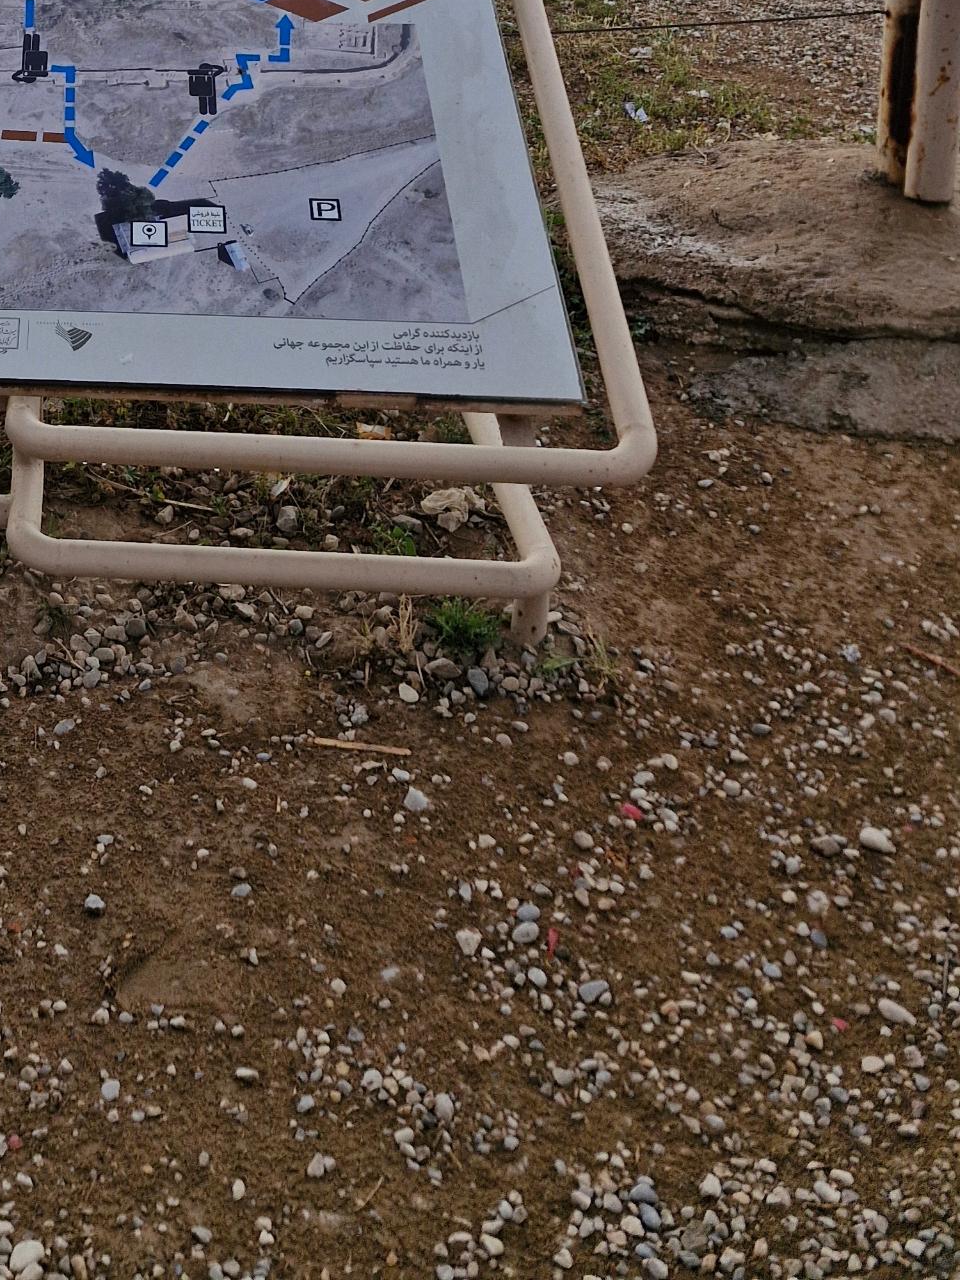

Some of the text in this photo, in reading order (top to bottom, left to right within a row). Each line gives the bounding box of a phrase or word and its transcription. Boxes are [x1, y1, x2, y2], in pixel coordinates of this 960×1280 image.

[316, 202, 336, 217] P
[393, 328, 421, 340] گرامی
[273, 338, 304, 350] جهانی
[308, 340, 350, 352] مجموعه
[353, 341, 369, 352] این
[382, 341, 421, 351] حفاظت
[424, 343, 444, 355] برای
[447, 344, 472, 356] اینکه
[384, 357, 419, 368] هستید
[420, 356, 430, 366] ما
[433, 358, 462, 368] همراه
